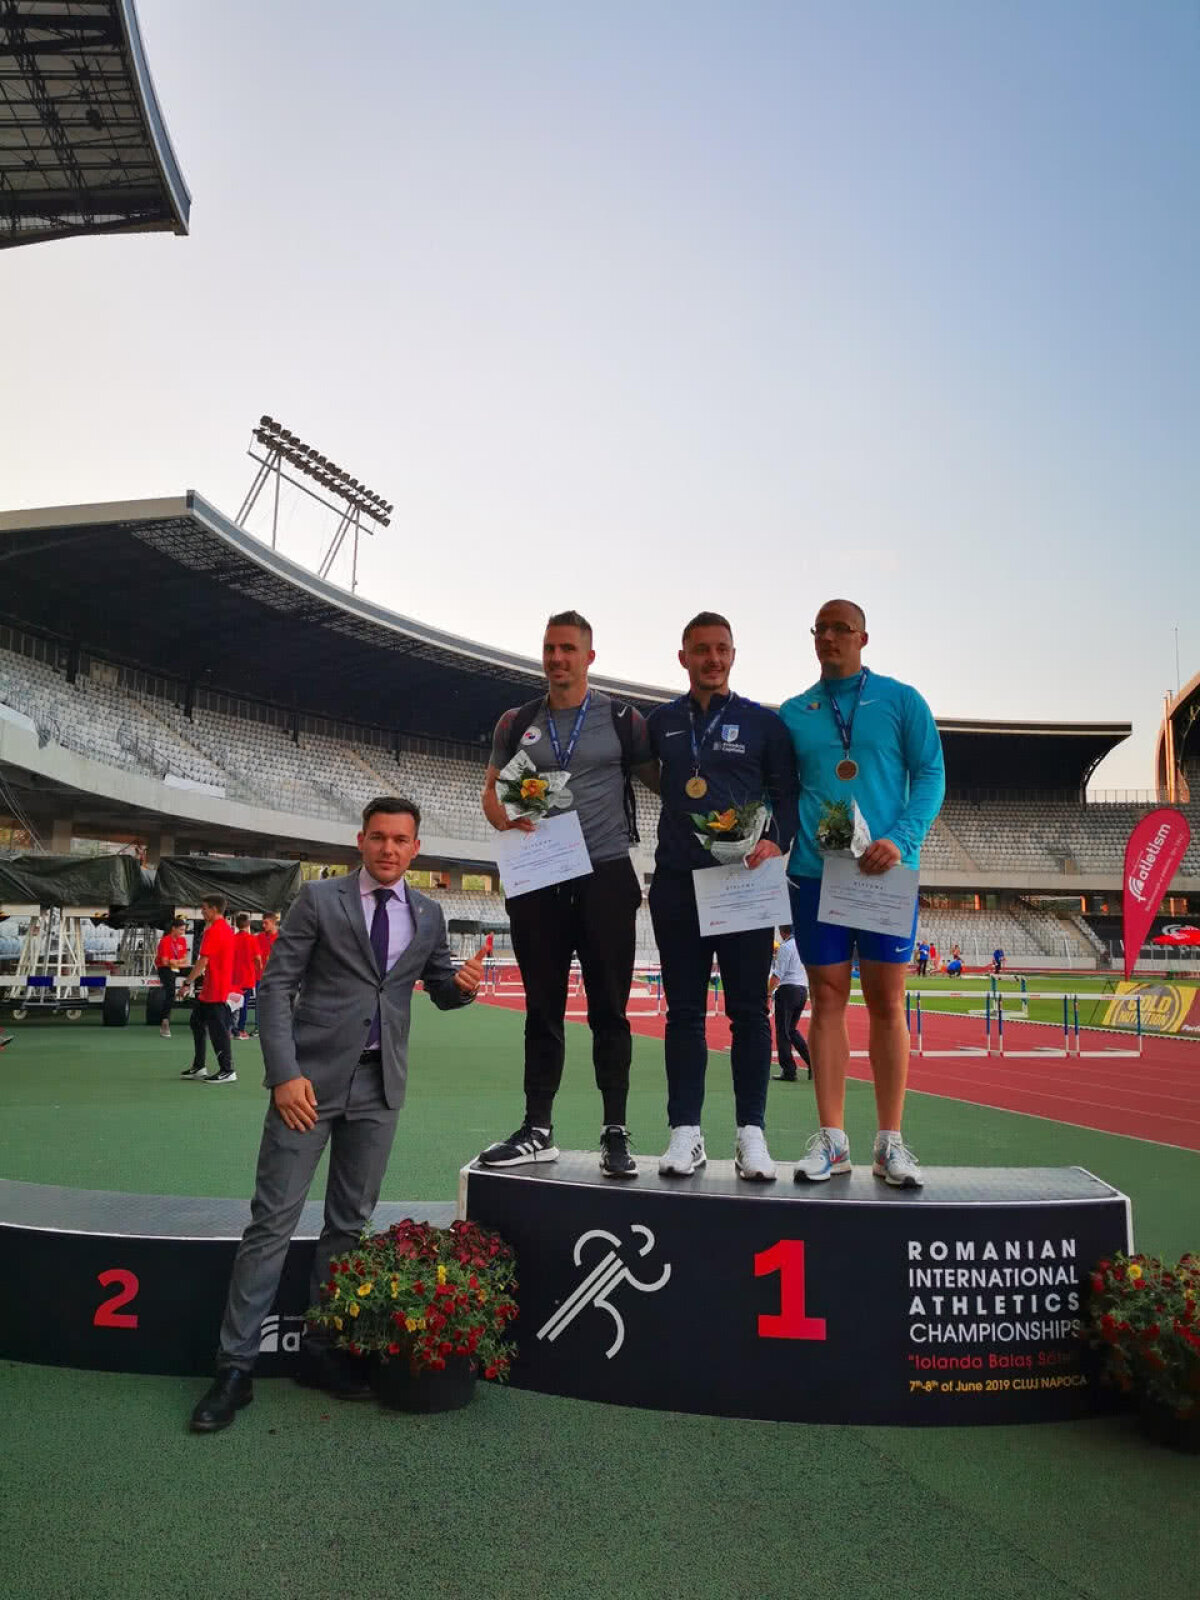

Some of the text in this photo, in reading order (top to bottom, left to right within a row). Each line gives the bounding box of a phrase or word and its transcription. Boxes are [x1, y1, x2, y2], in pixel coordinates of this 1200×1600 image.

[908, 1239, 1076, 1261] ROMANIAN
[909, 1266, 1079, 1288] INTERNATIONAL
[93, 1268, 139, 1328] 2
[754, 1240, 826, 1340] 1
[909, 1292, 1080, 1315] ATHLETICS
[909, 1319, 1081, 1343] CHAMPIONSHIPS
[941, 1379, 953, 1392] of
[955, 1380, 983, 1392] June
[985, 1379, 1010, 1391] 2019
[1012, 1378, 1039, 1391] CLUJ
[1041, 1374, 1089, 1388] NAPOCA
